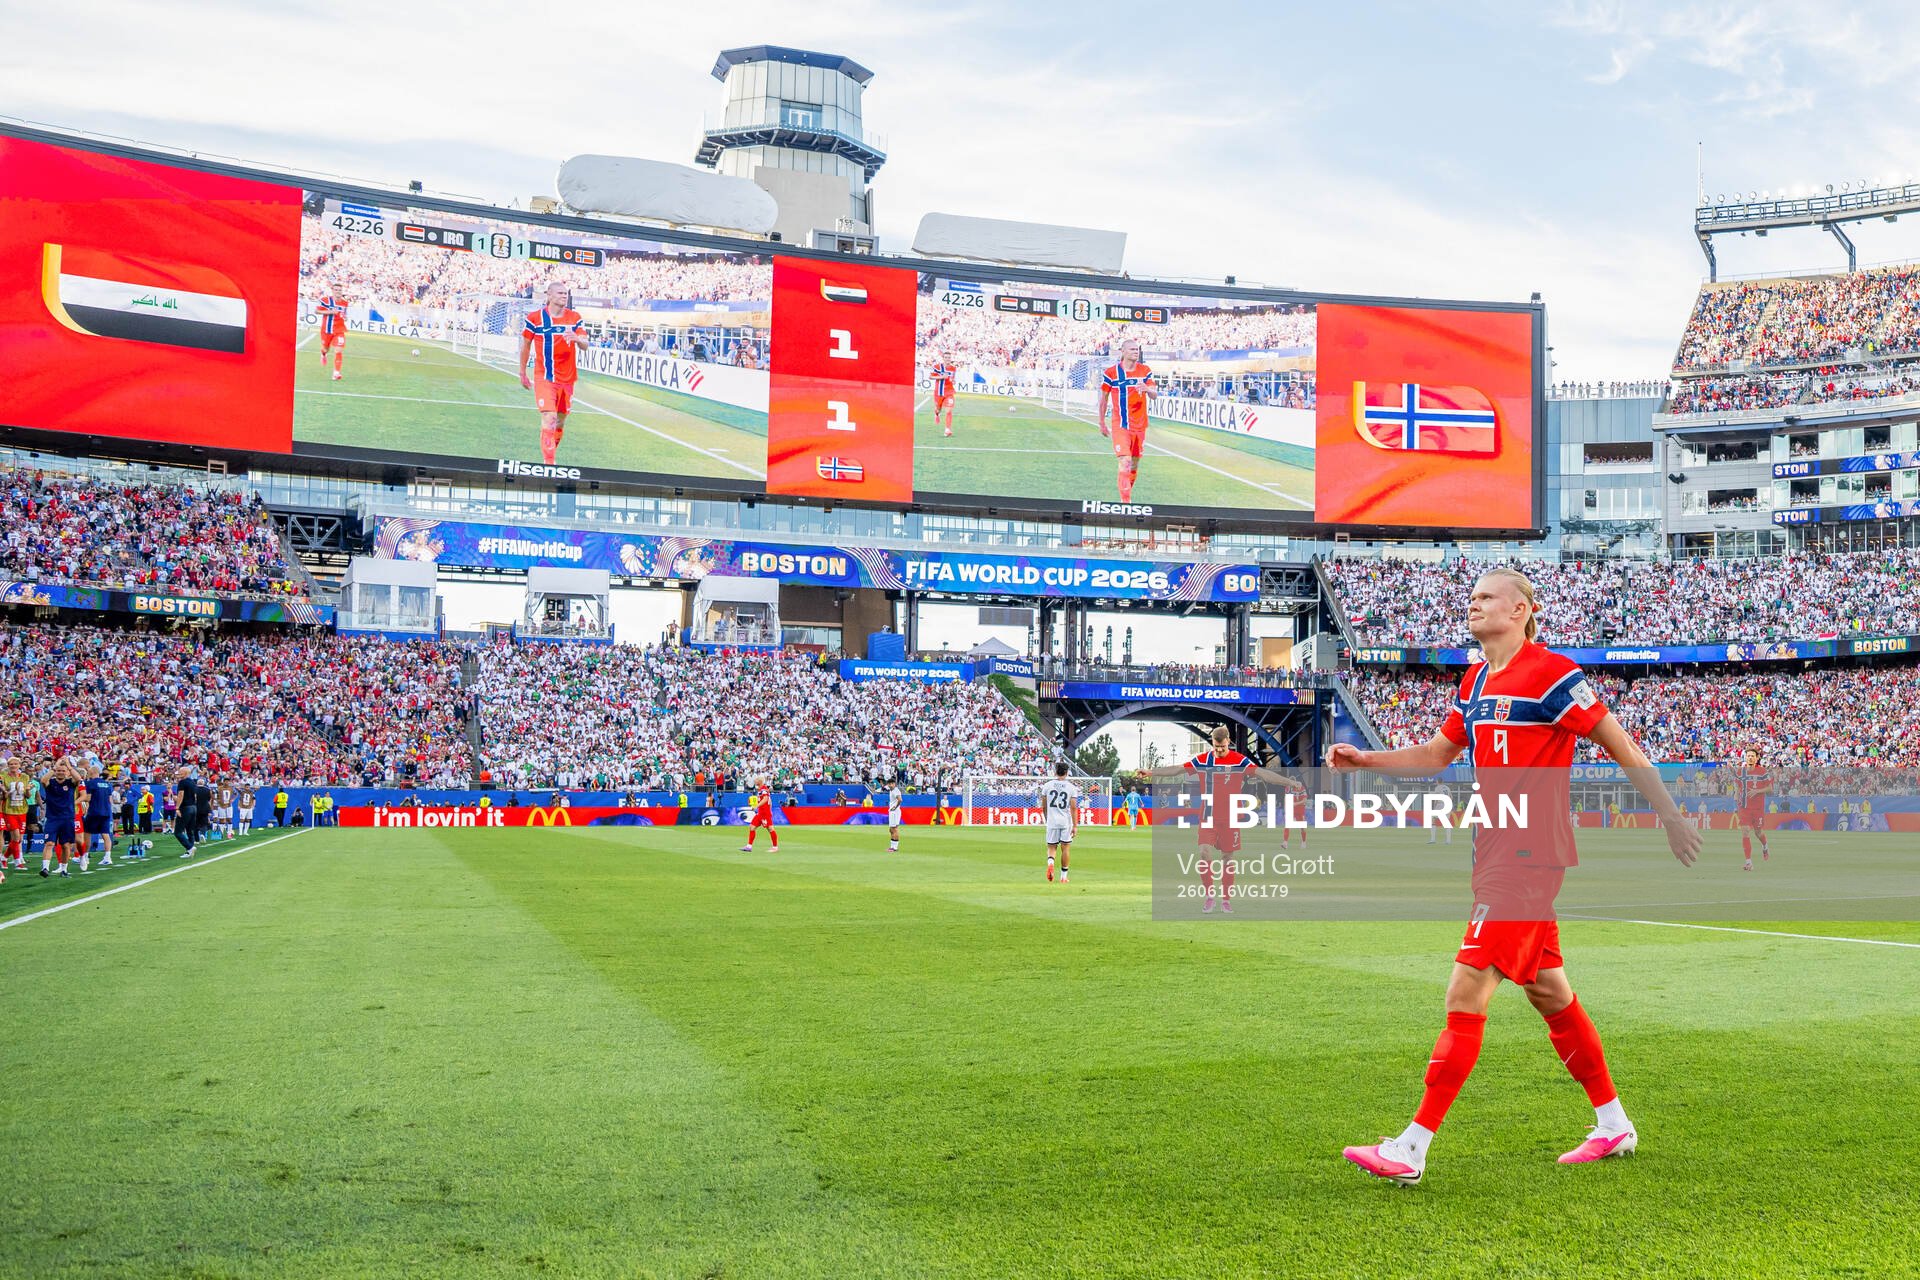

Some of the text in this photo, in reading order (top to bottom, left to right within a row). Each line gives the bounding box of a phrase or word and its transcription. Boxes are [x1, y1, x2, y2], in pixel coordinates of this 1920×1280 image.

[332, 216, 560, 259] 42:26 IRQ 1 1 NOR
[942, 292, 1132, 319] 42:26 IRQ 1 1 NOR
[829, 329, 858, 360] 1
[600, 350, 614, 373] OF
[616, 353, 680, 389] AMERICA
[827, 400, 856, 432] 1
[1167, 399, 1179, 419] OF
[1181, 400, 1237, 431] AMERICA
[497, 459, 581, 480] Hisense
[1082, 500, 1153, 516] Hisense
[478, 537, 583, 562] #FIFAWorldCup
[742, 552, 846, 576] BOSTON
[906, 561, 1169, 589] FIFA WORLD CUP 2026
[135, 596, 215, 615] BOSTON
[1854, 638, 1907, 653] BOSTON
[1606, 650, 1661, 662] #FIFAWorldCup
[854, 667, 873, 676] FIFA
[875, 668, 908, 677] WORLD
[909, 669, 928, 678] CUP
[995, 661, 1031, 675] BOSTON
[1121, 687, 1240, 700] FIFA WORLD CUP 2026
[1493, 729, 1508, 765] 9
[618, 798, 649, 807] FFA
[1049, 790, 1068, 809] 23
[1838, 803, 1860, 813] FFA
[374, 807, 504, 827] i'm lovin' it
[988, 807, 1018, 826] i'm
[1080, 807, 1094, 826] it
[1471, 903, 1490, 938] 9
